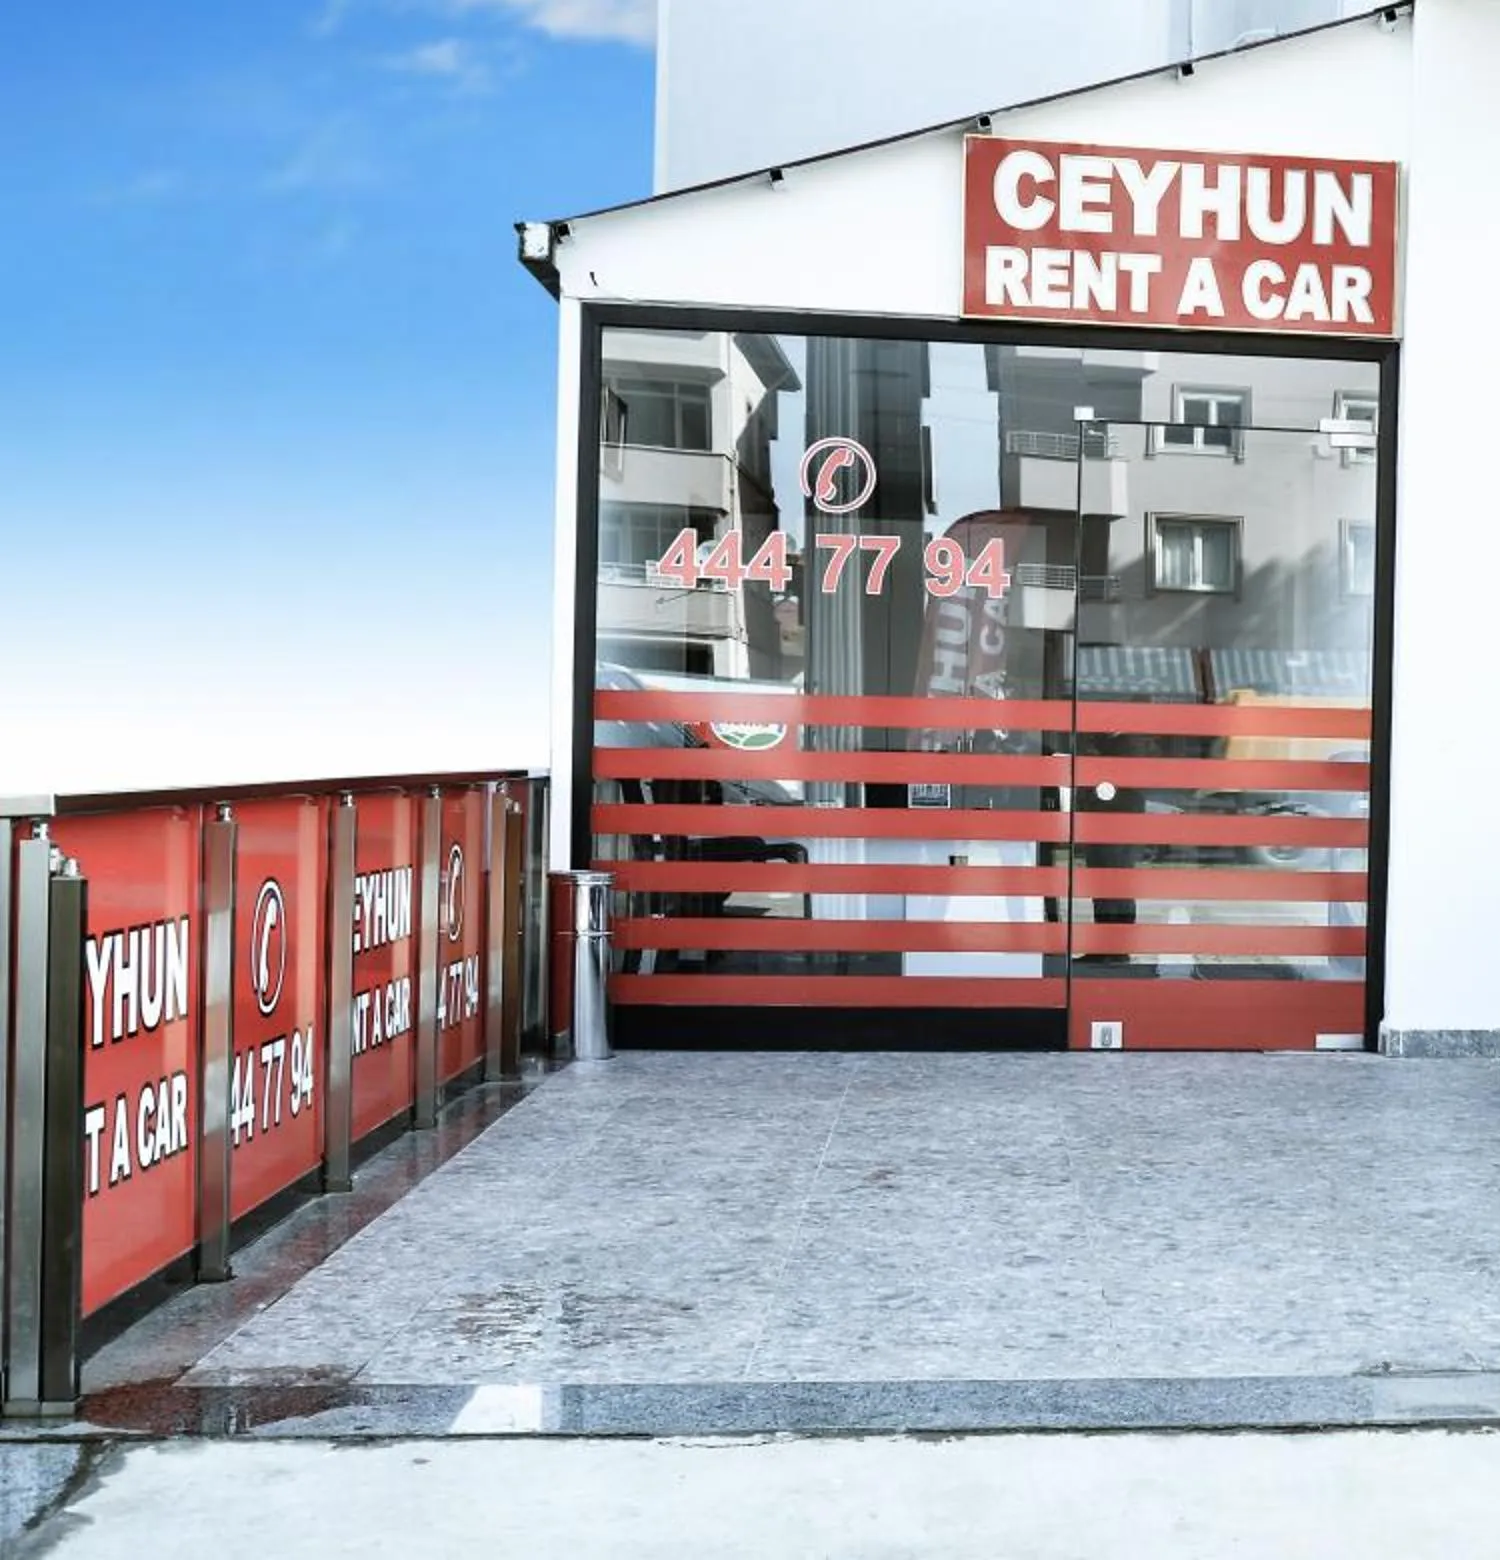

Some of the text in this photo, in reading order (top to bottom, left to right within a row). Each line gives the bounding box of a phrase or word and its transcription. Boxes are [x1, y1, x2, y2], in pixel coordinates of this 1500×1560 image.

[993, 149, 1373, 248] CEYHUN
[984, 244, 1375, 324] RENT A CAR
[657, 527, 1011, 599] 444 77 94
[385, 976, 412, 1041] CAR
[449, 959, 463, 1028] 77
[261, 1035, 286, 1133] 77
[291, 1021, 313, 1117] 94
[109, 1092, 132, 1188] A
[136, 1069, 188, 1171] CAR
